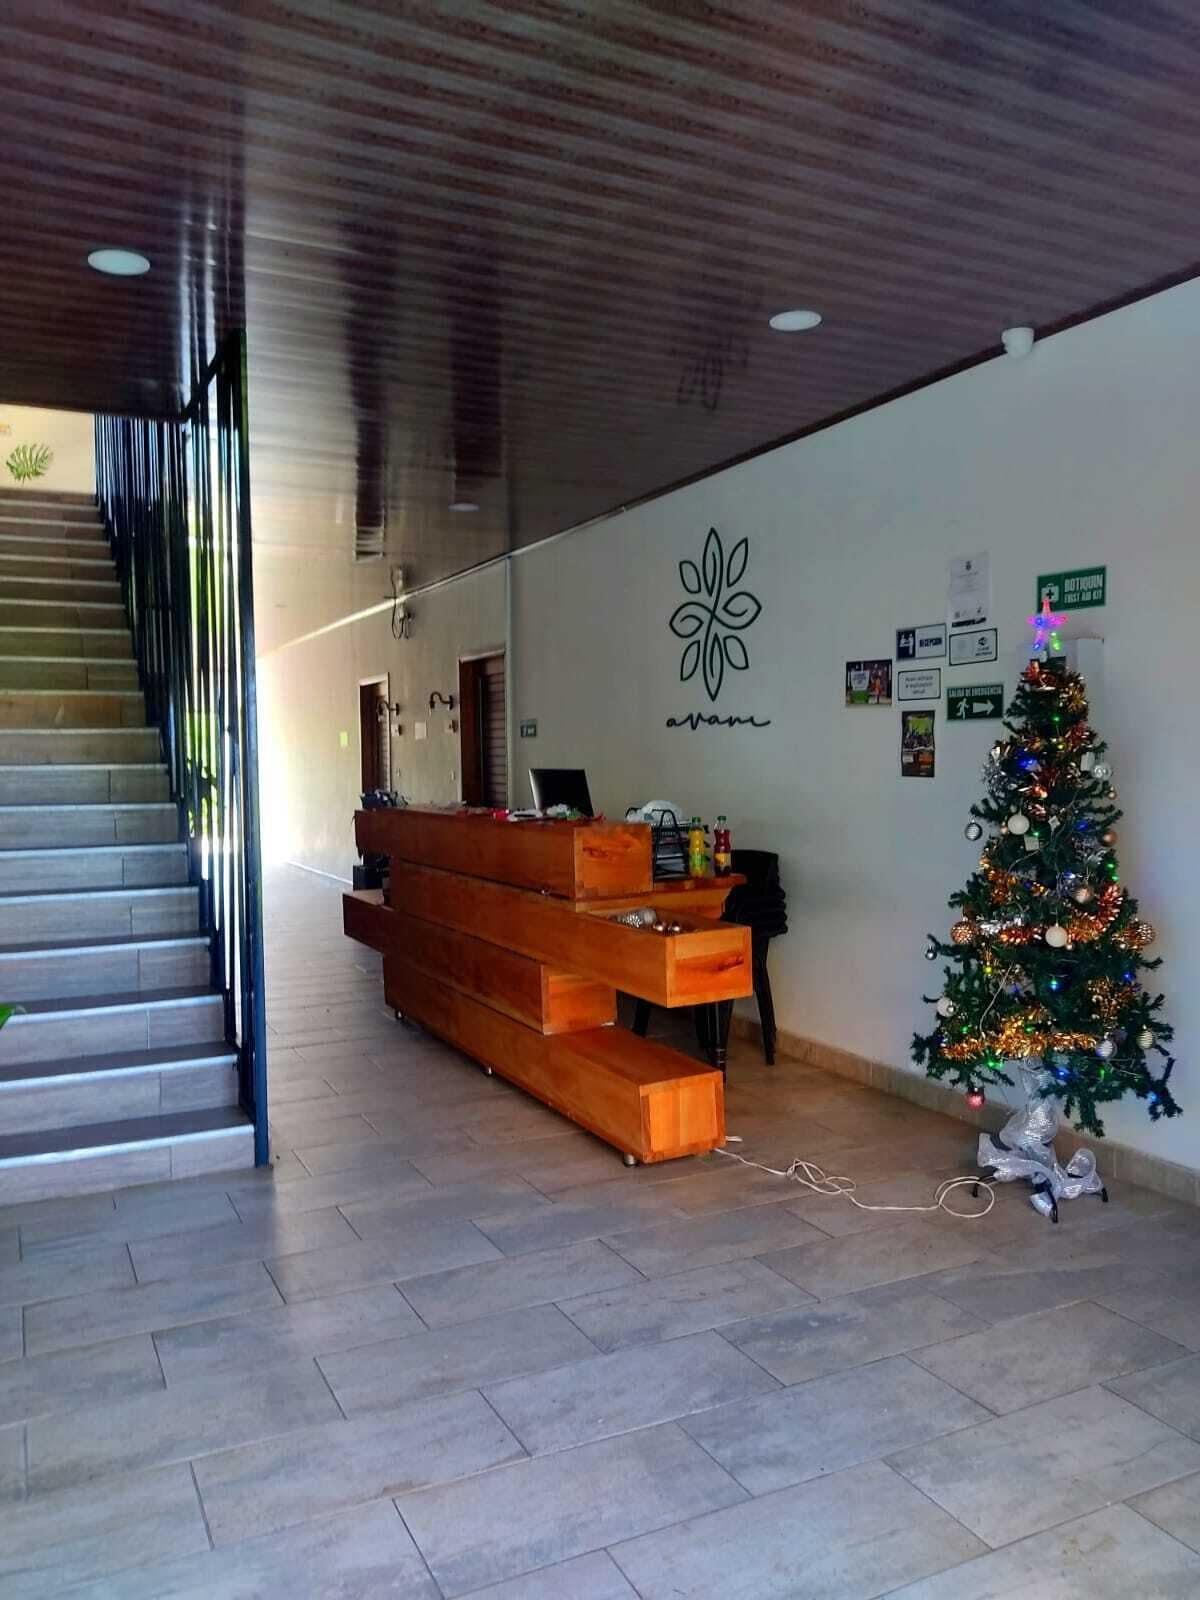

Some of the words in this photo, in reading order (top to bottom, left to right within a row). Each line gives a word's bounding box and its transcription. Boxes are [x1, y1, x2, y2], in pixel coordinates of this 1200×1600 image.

[1064, 593, 1080, 604] FIRST
[1081, 591, 1092, 602] AID
[1092, 589, 1103, 600] KIT
[949, 688, 964, 698] SALIDA
[965, 688, 971, 697] DE
